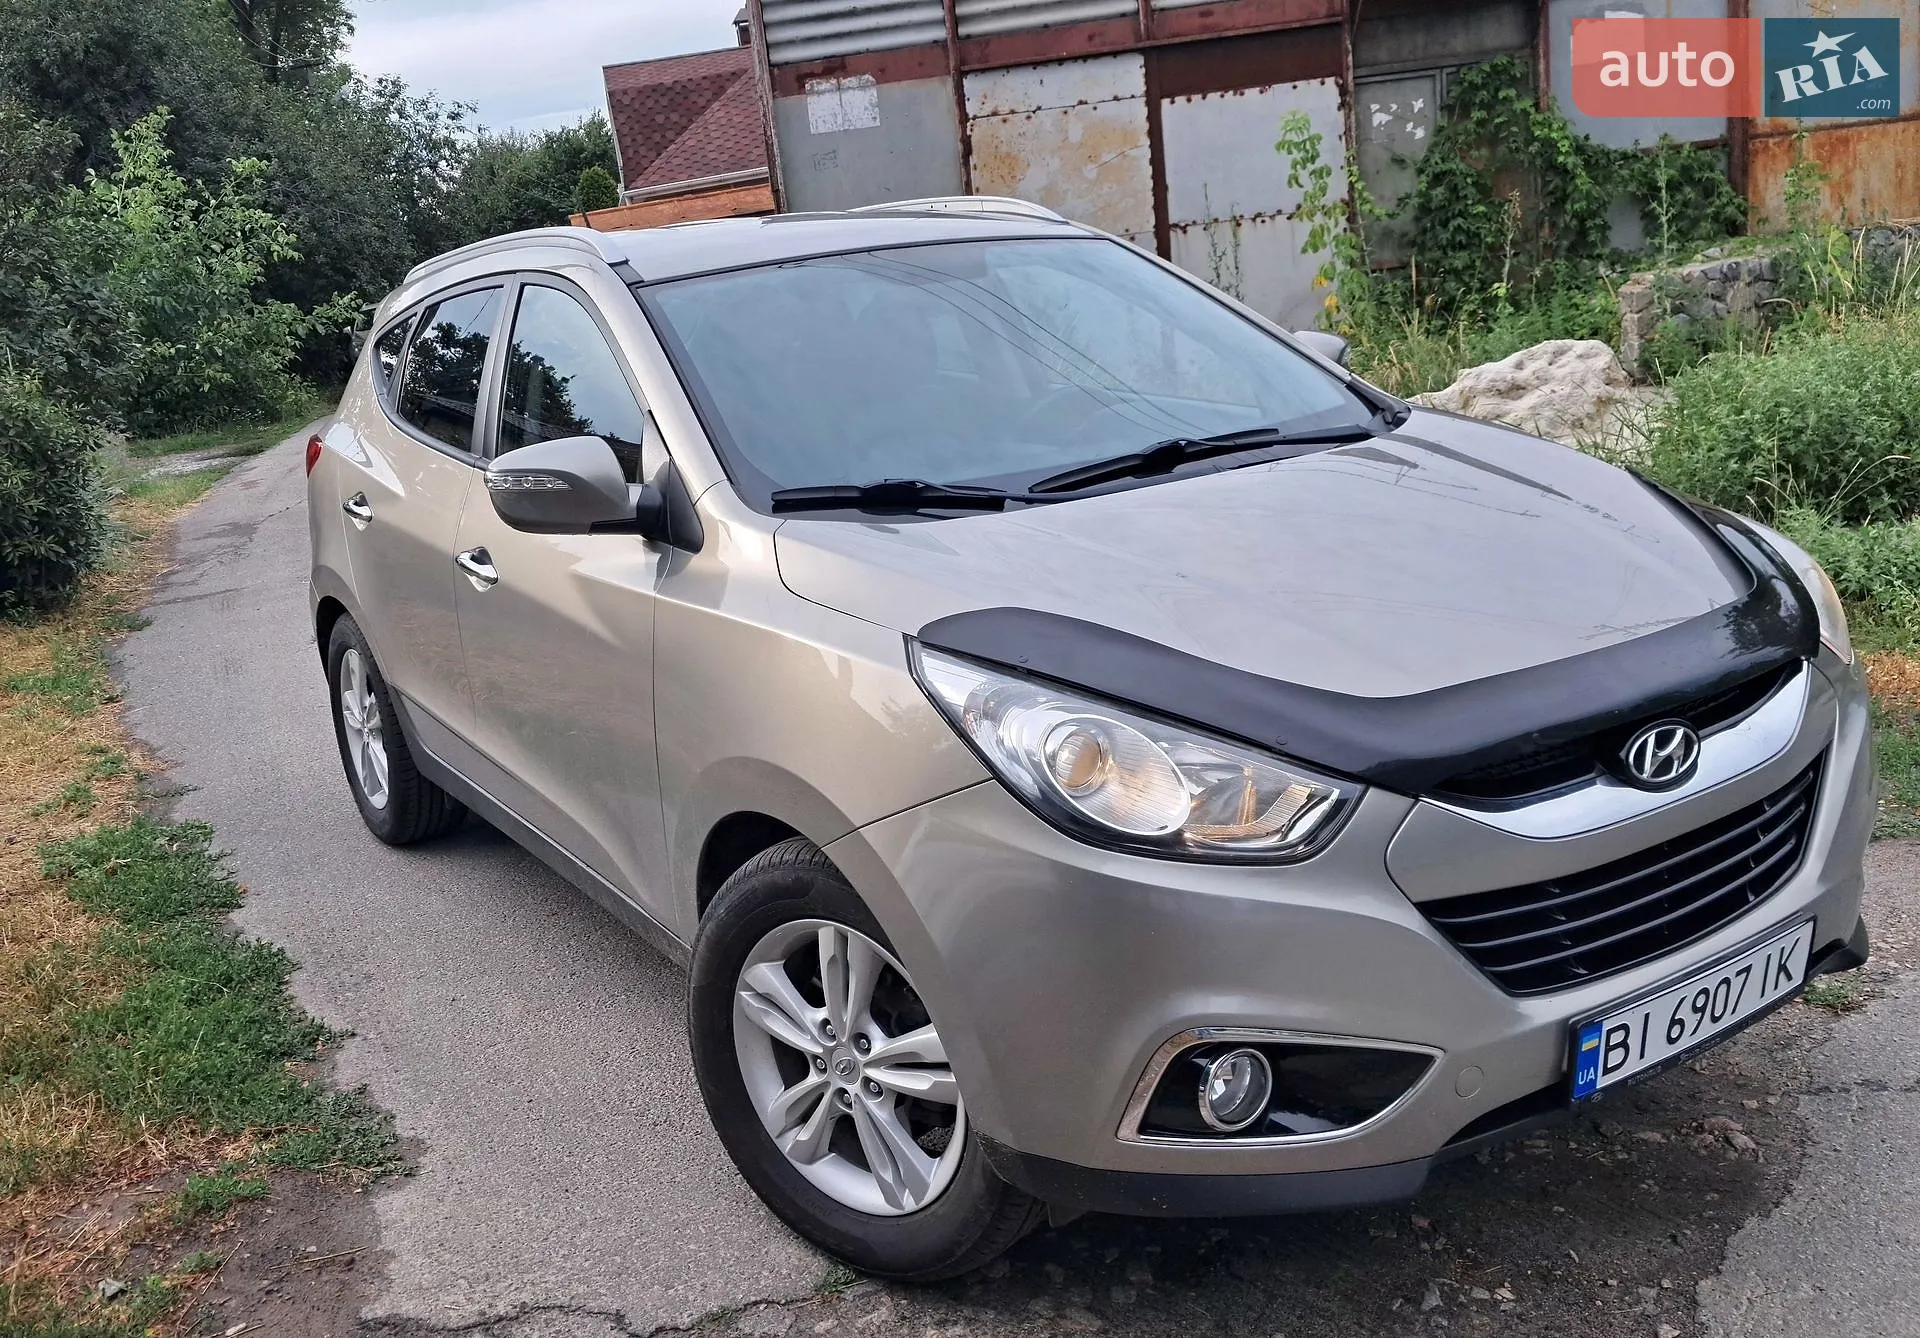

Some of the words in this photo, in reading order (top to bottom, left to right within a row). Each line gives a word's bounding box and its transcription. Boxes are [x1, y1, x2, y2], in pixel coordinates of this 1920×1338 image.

[1601, 1011, 1650, 1077] BI
[1666, 963, 1753, 1045] 6907
[1760, 936, 1801, 999] IK
[1578, 1067, 1595, 1085] UA
